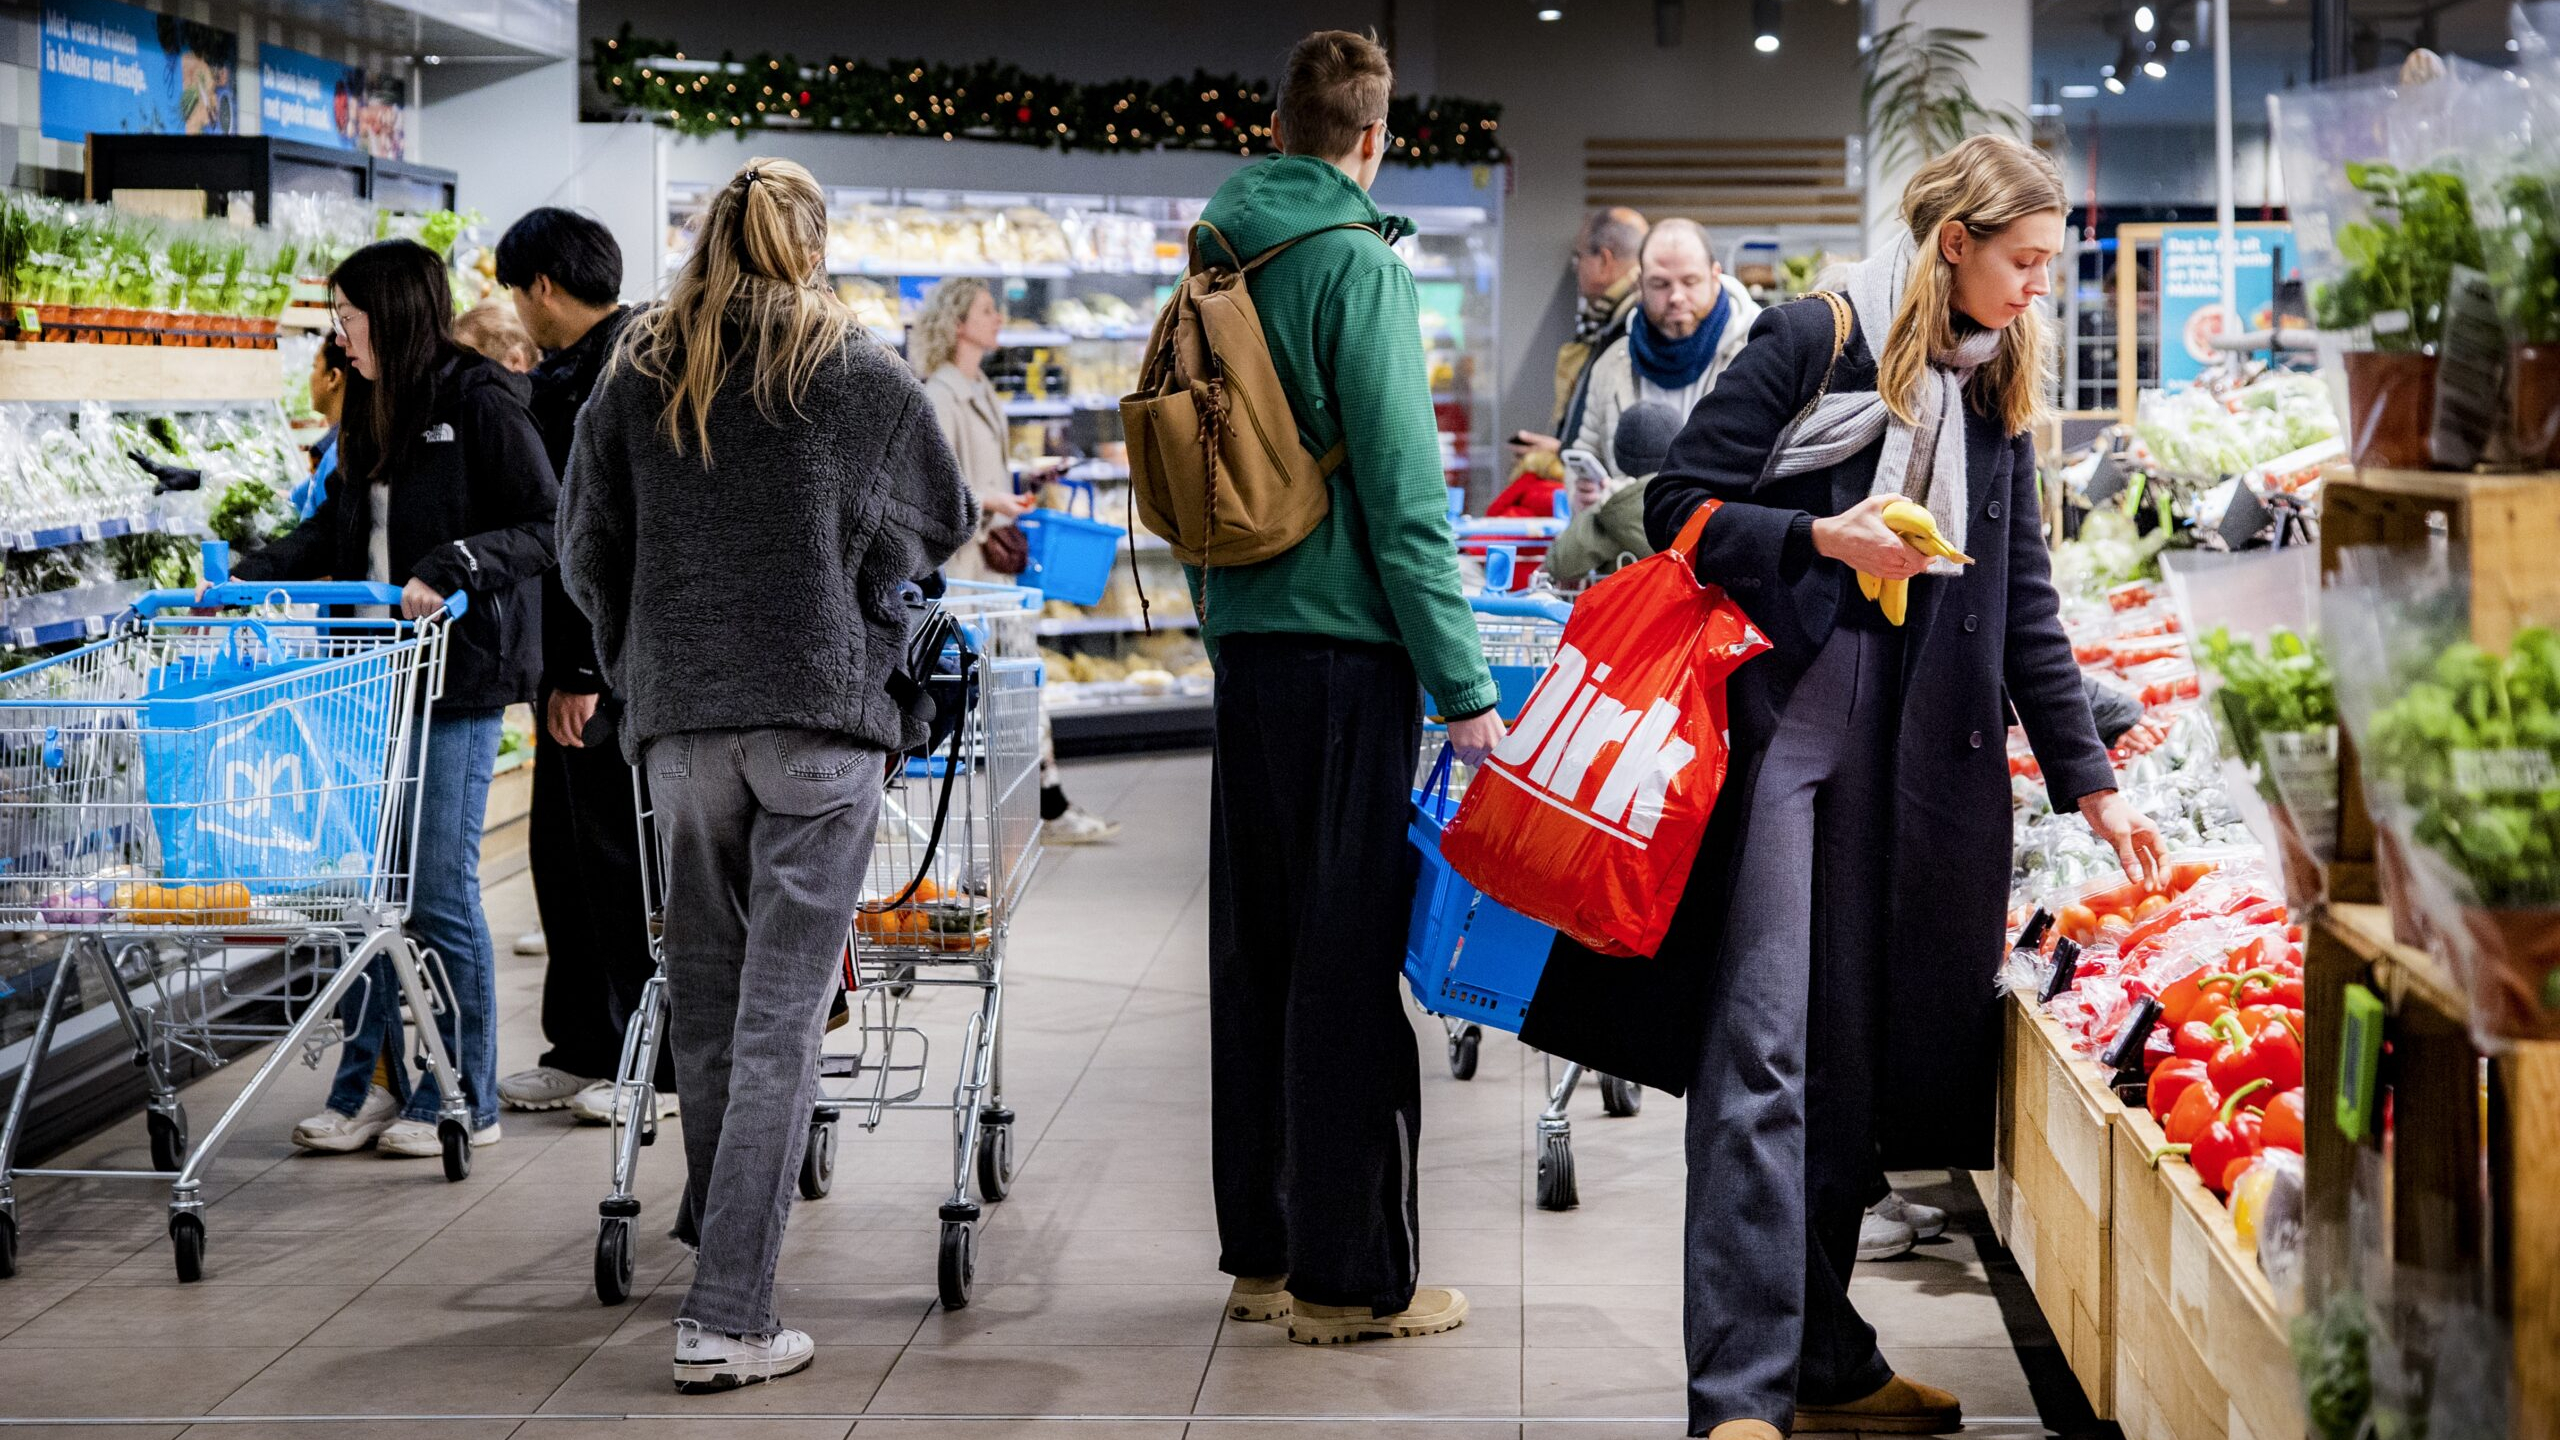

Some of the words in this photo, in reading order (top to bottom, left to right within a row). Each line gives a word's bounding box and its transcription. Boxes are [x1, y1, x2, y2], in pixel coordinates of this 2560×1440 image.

[46, 7, 68, 40] Met
[70, 20, 99, 47] verse
[101, 18, 137, 56] kruiden
[46, 40, 56, 73] is
[58, 42, 90, 80] koken
[92, 58, 110, 84] een
[1490, 642, 1696, 840] Dirk
